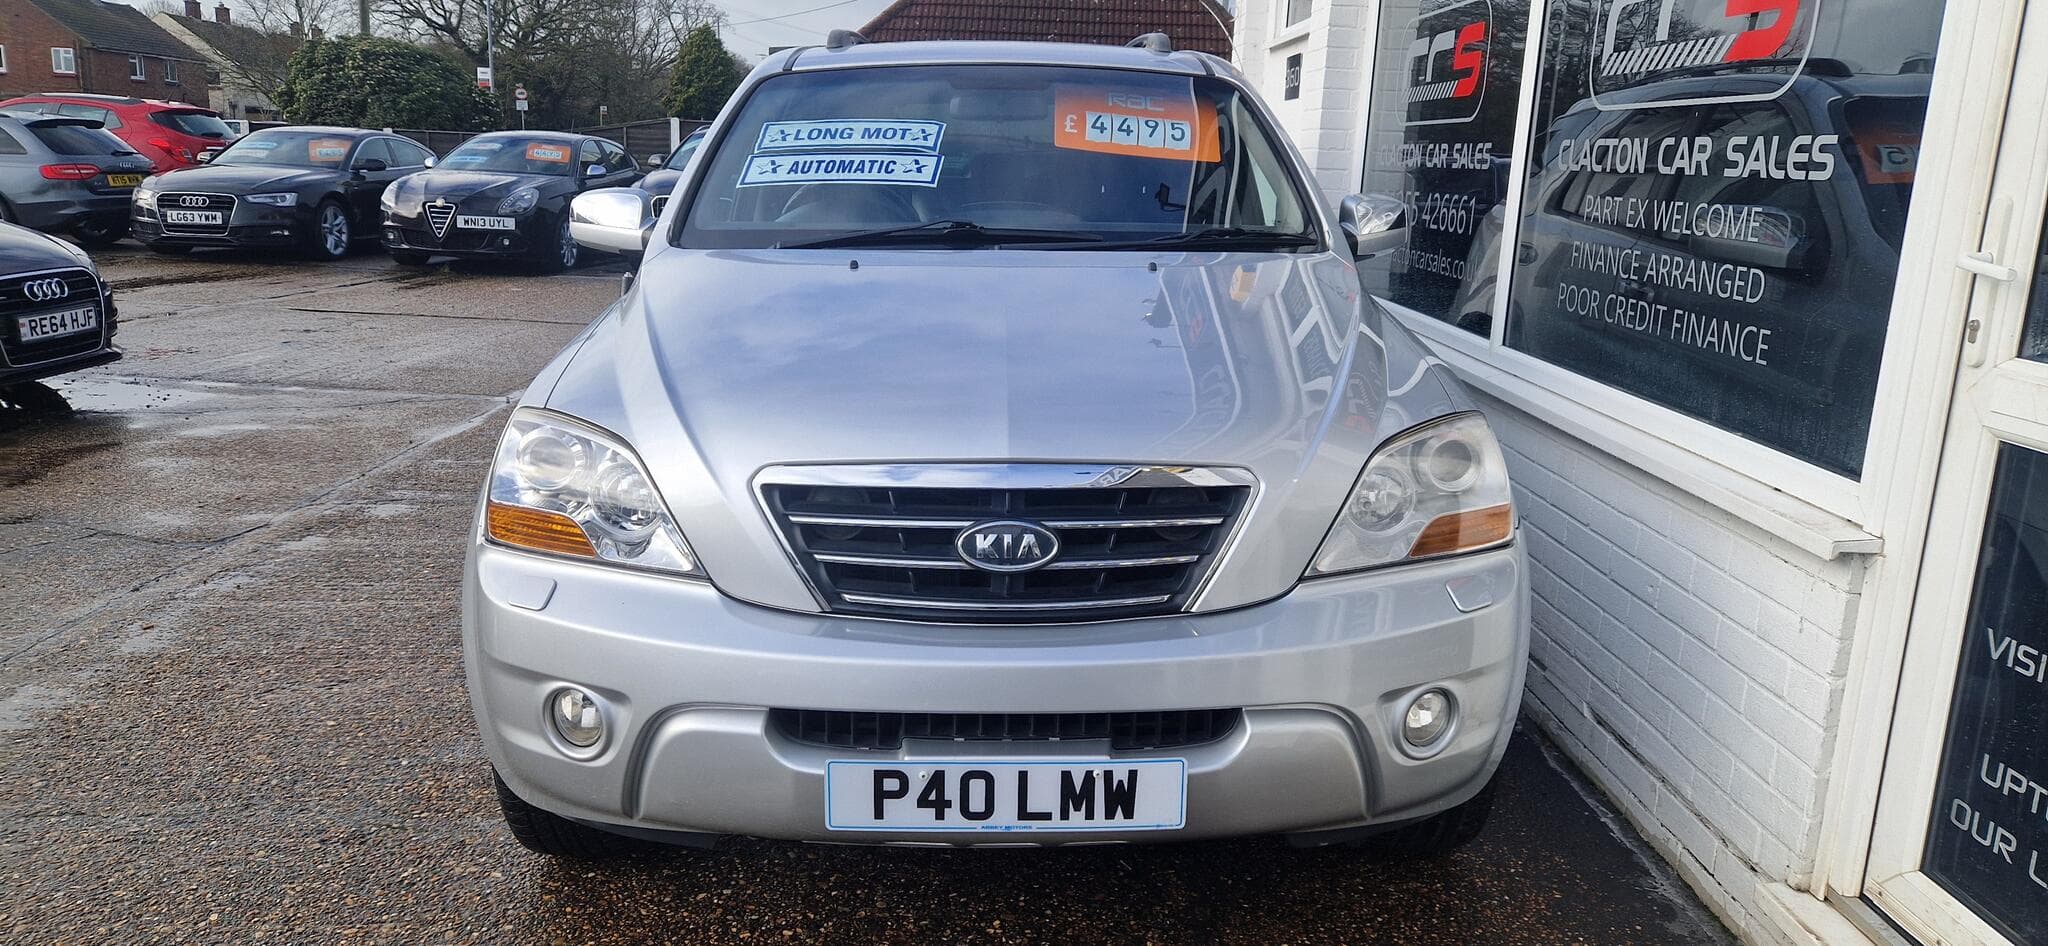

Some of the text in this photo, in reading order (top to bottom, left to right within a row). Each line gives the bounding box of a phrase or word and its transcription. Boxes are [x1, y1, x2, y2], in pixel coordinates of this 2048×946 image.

[793, 127, 911, 141] LONG MOT
[1064, 114, 1187, 142] £ 4495
[786, 158, 898, 175] AUTOMATIC
[1425, 143, 1449, 169] CAR
[1451, 142, 1493, 170] SALES
[1558, 136, 1649, 174] CLACTON
[1657, 136, 1713, 176] CAR
[1722, 134, 1840, 181] SALES
[170, 212, 218, 223] LG63 YWM
[463, 217, 509, 228] WN13 UYL
[1422, 191, 1477, 236] 426661
[1584, 195, 1764, 243] PART EX WELCOME
[1391, 247, 1478, 282] actoncarsales.co.uk
[1570, 241, 1766, 304] FINANCE ARRANGED
[28, 309, 94, 337] RE64 HJF
[1557, 283, 1772, 366] POOR CREDIT FINANCE
[974, 533, 1042, 559] KIA
[1987, 627, 2048, 683] VISI
[873, 768, 1139, 822] P40 LMW
[1981, 753, 2048, 822] UPT
[1950, 798, 2048, 890] OUR L
